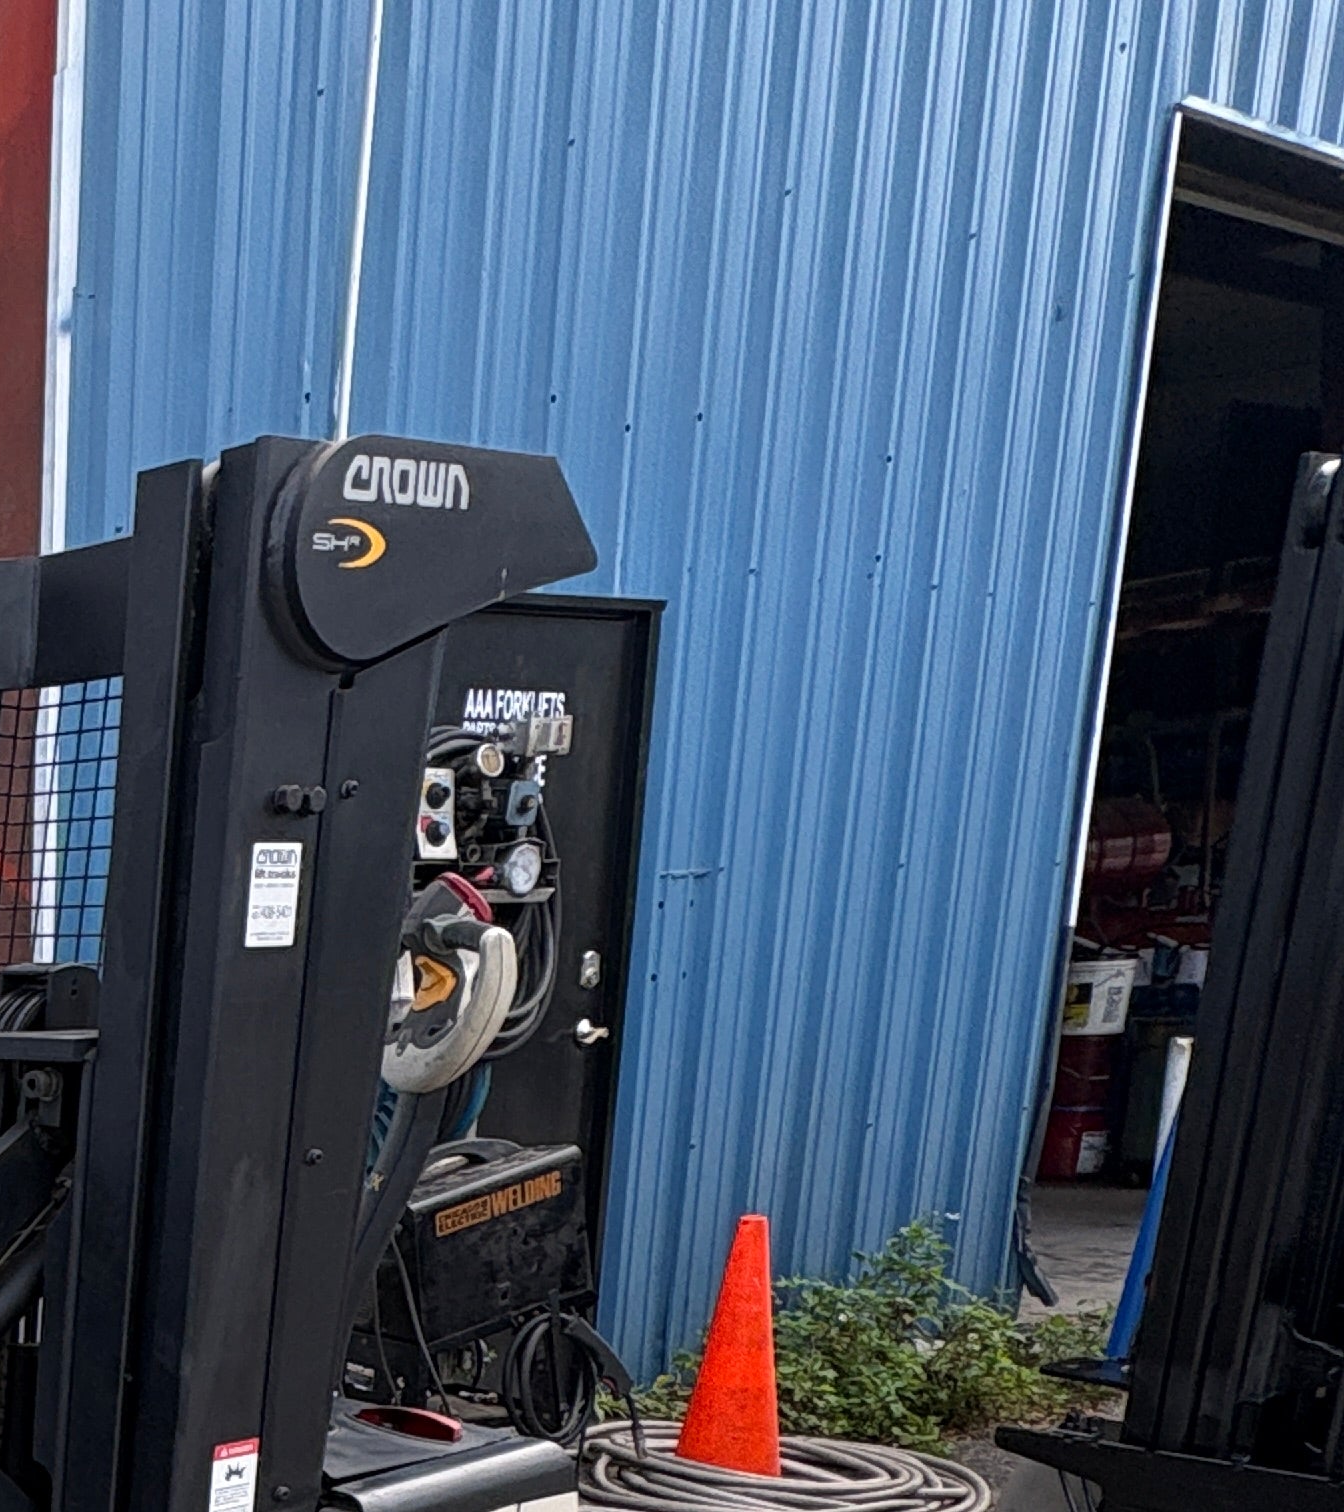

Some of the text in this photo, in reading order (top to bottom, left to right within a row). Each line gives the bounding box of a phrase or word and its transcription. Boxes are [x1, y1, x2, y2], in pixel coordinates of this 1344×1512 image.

[343, 454, 470, 510] CROWN
[464, 688, 566, 721] AAA FORKLIFTS
[491, 1170, 562, 1217] WELDING
